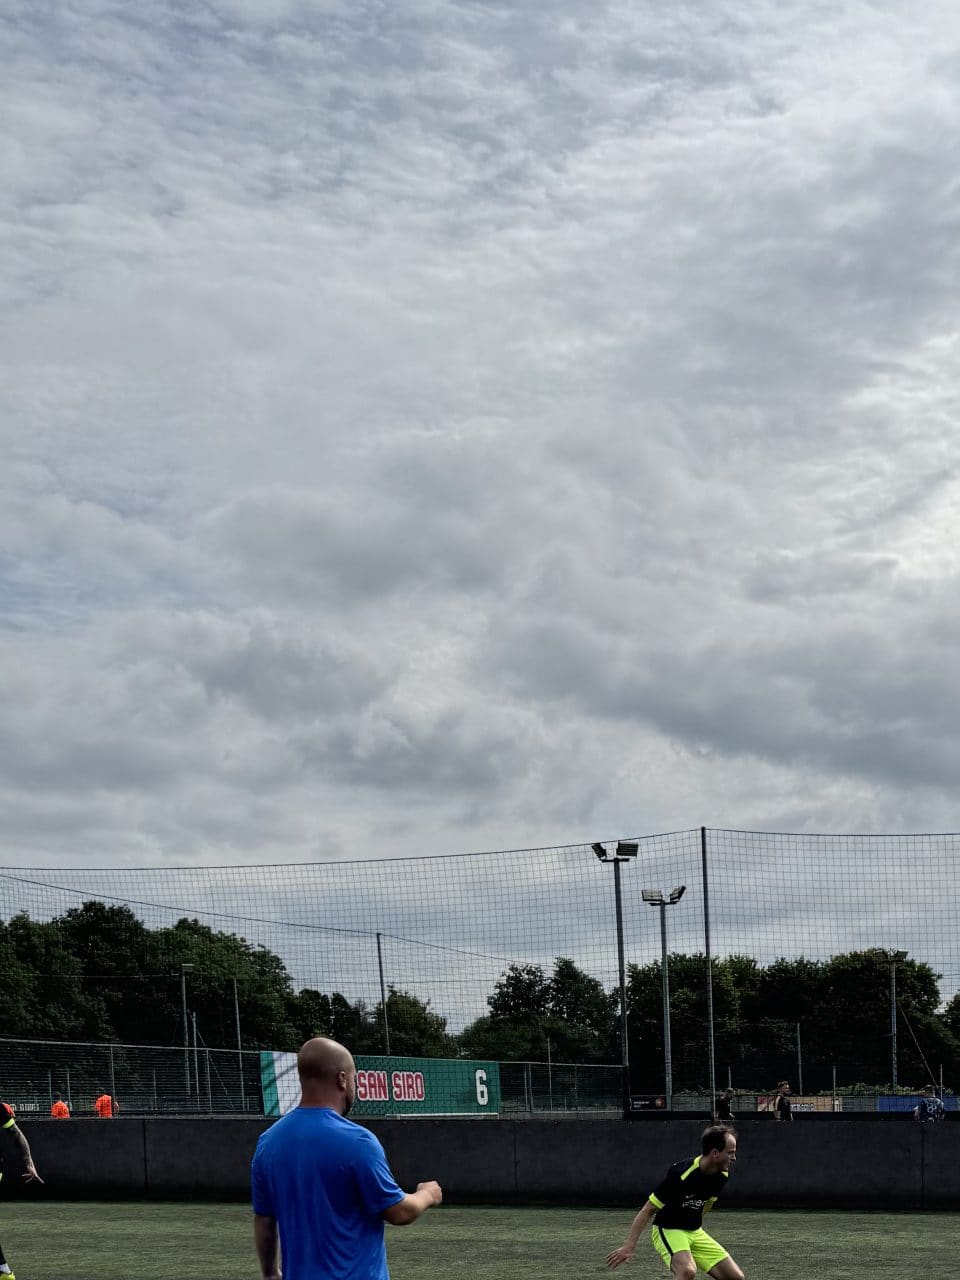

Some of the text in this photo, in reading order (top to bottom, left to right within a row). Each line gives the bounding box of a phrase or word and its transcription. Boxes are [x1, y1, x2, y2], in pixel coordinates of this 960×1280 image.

[356, 1070, 425, 1101] SAN SIRO
[475, 1069, 489, 1106] 6
